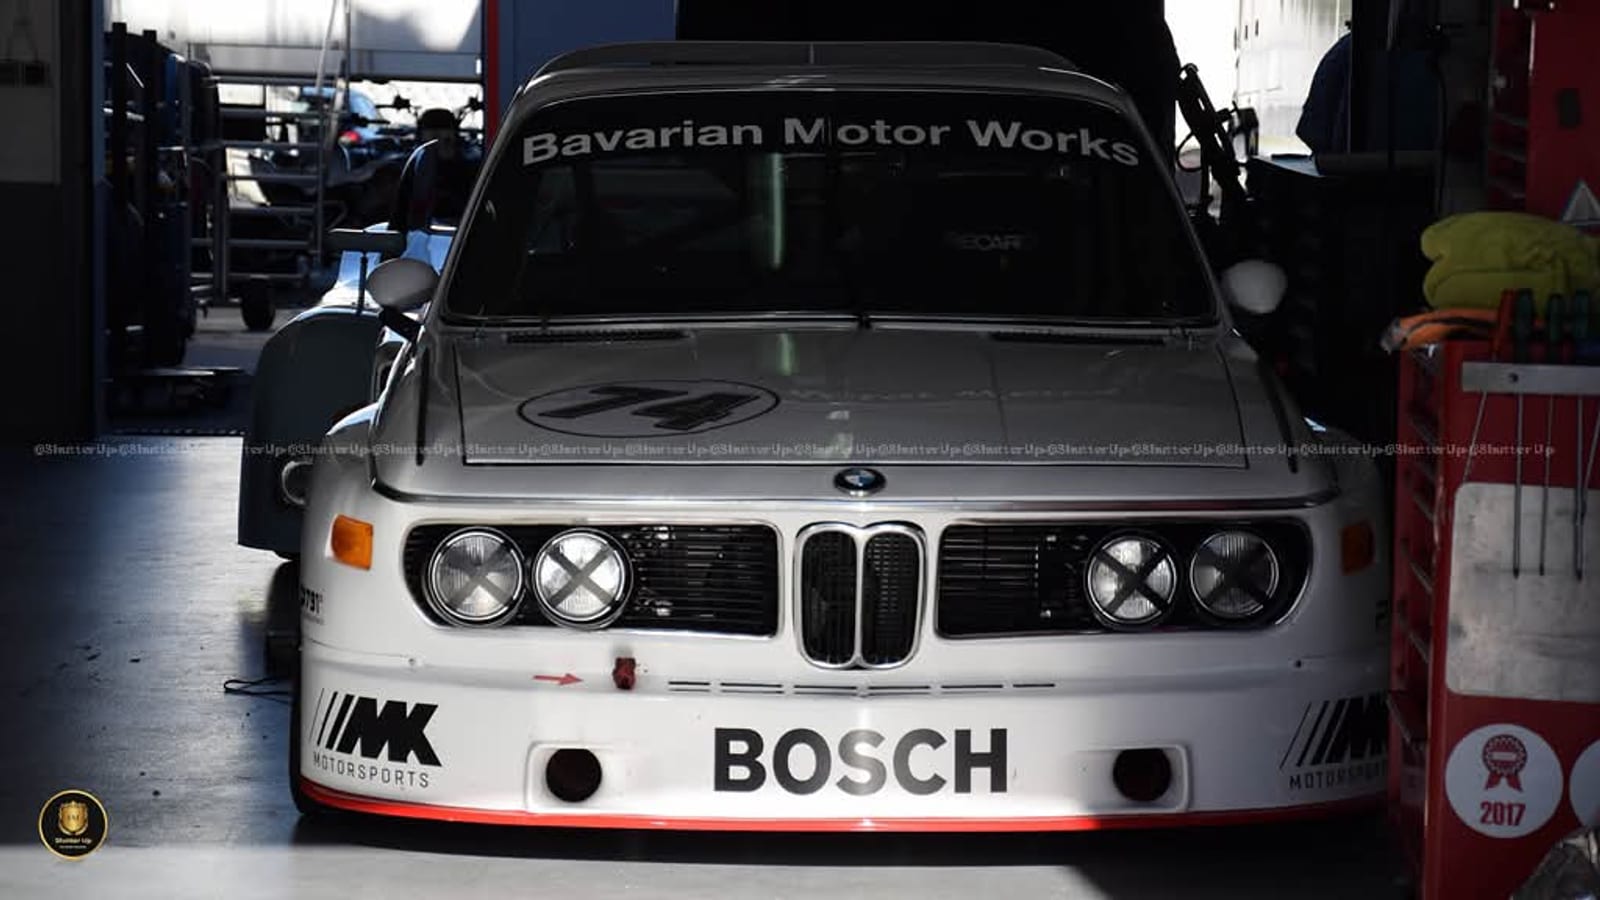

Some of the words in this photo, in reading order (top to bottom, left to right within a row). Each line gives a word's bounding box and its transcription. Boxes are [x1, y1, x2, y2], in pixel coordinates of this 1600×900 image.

[523, 120, 763, 166] Bavarian
[784, 117, 951, 146] Motor
[966, 119, 1140, 167] Works
[537, 386, 761, 430] 74
[313, 751, 430, 789] MOTORSPORTS
[714, 727, 1007, 796] BOSCH
[1289, 760, 1389, 790] MOTORSPO
[1480, 801, 1526, 826] 2017
